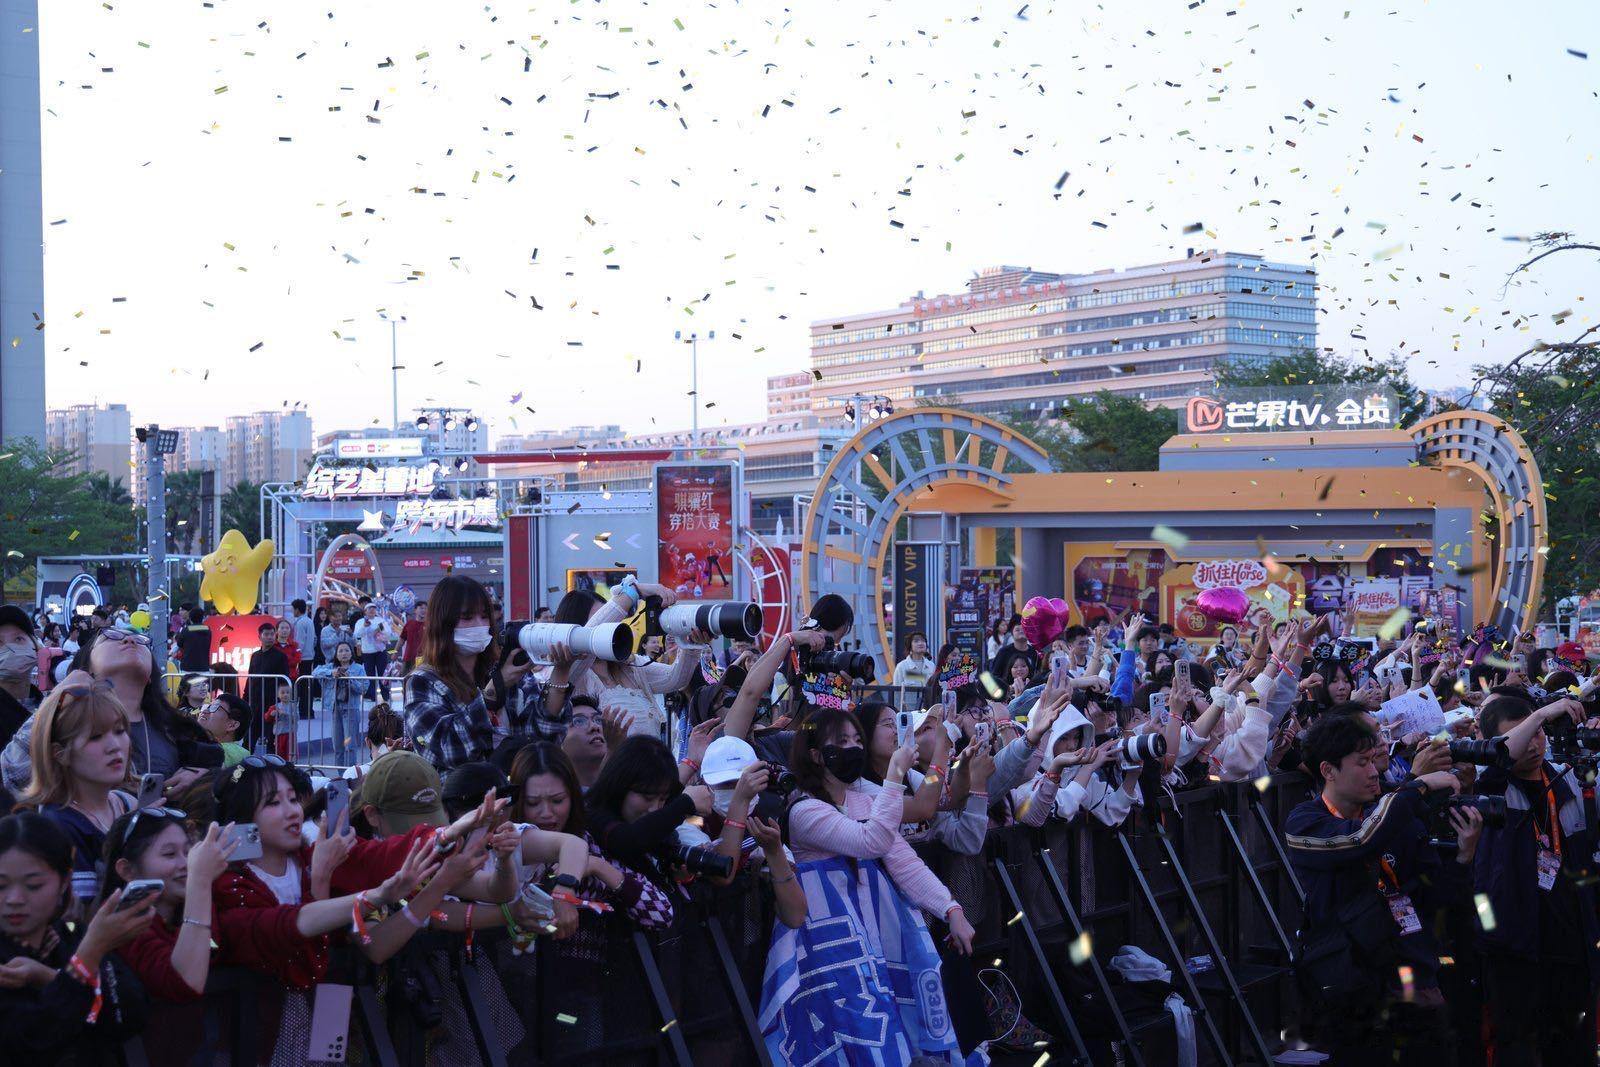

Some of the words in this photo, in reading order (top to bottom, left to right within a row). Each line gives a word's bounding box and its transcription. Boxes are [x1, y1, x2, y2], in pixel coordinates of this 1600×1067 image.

[1335, 398, 1390, 425] 会员
[391, 498, 498, 535] 跨年市集
[669, 513, 720, 531] 穿搭大赛
[905, 547, 917, 571] VIP
[905, 580, 917, 626] MGTV
